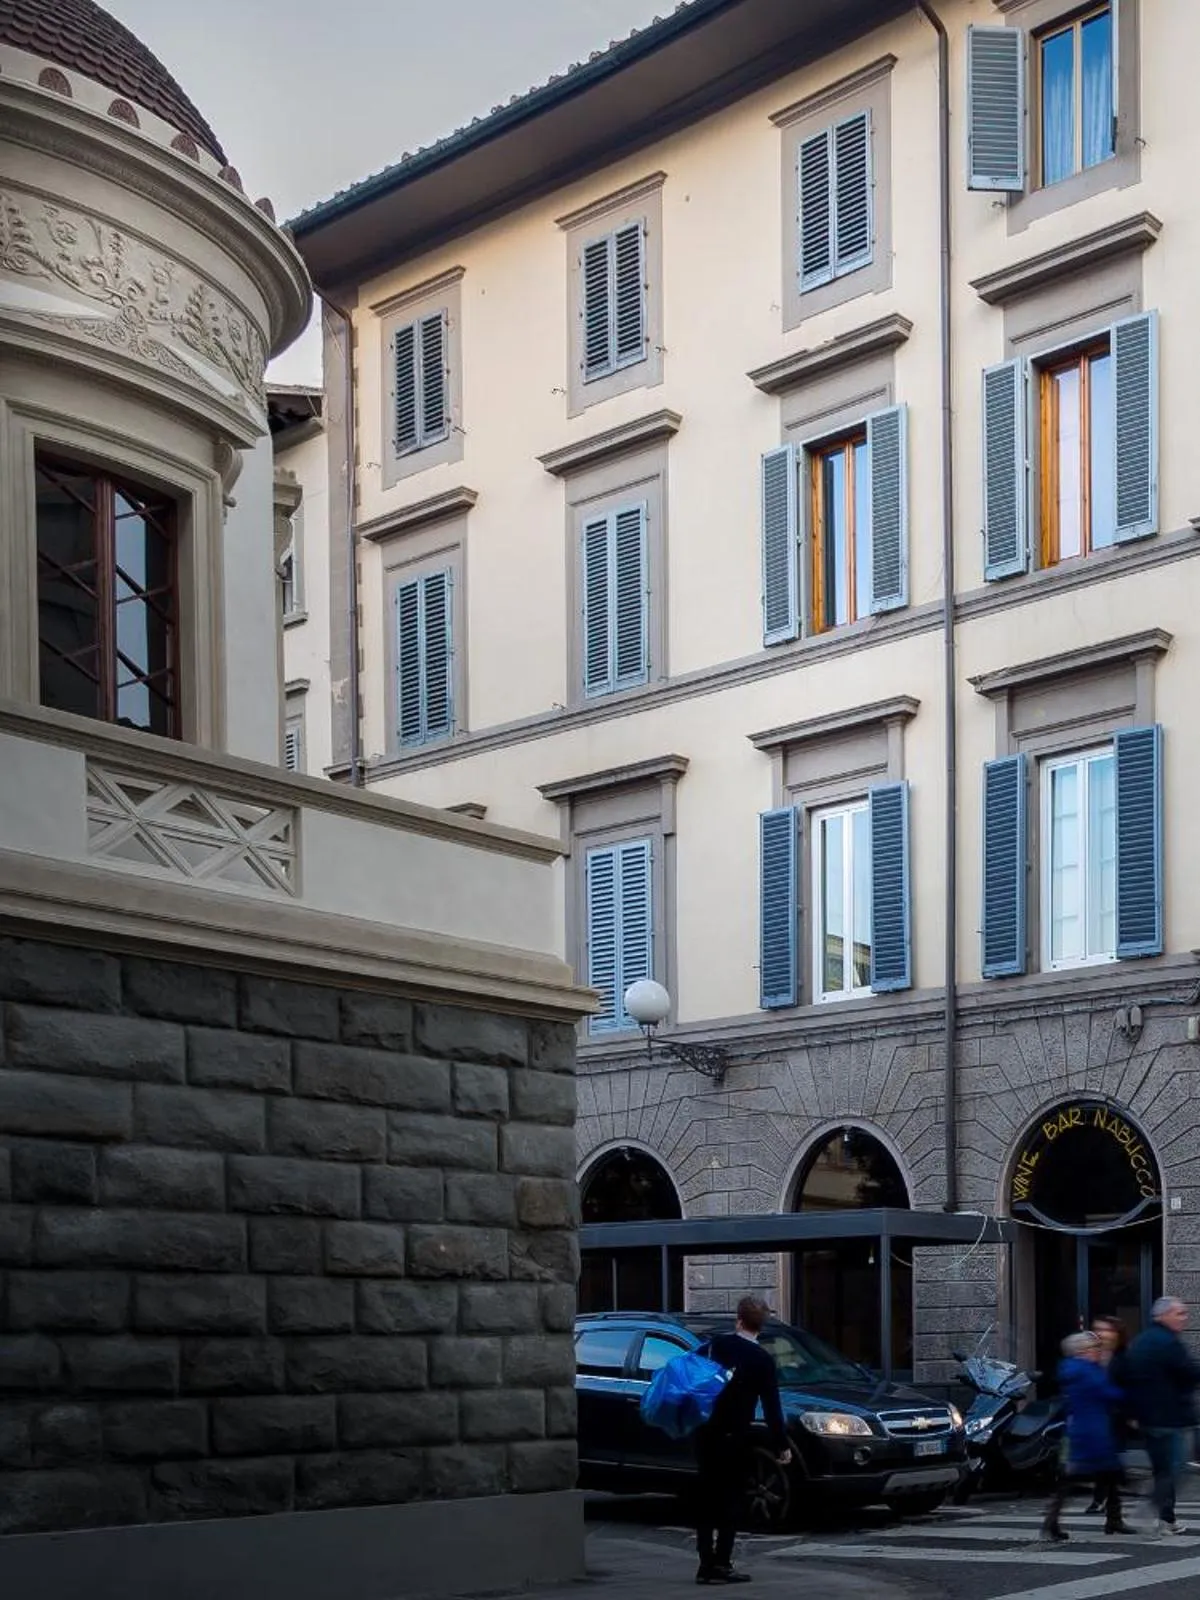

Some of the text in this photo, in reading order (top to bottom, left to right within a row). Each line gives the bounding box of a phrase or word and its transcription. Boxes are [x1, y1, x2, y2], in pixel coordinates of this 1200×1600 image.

[1012, 1105, 1156, 1202] WINE BAR NABUCCO
